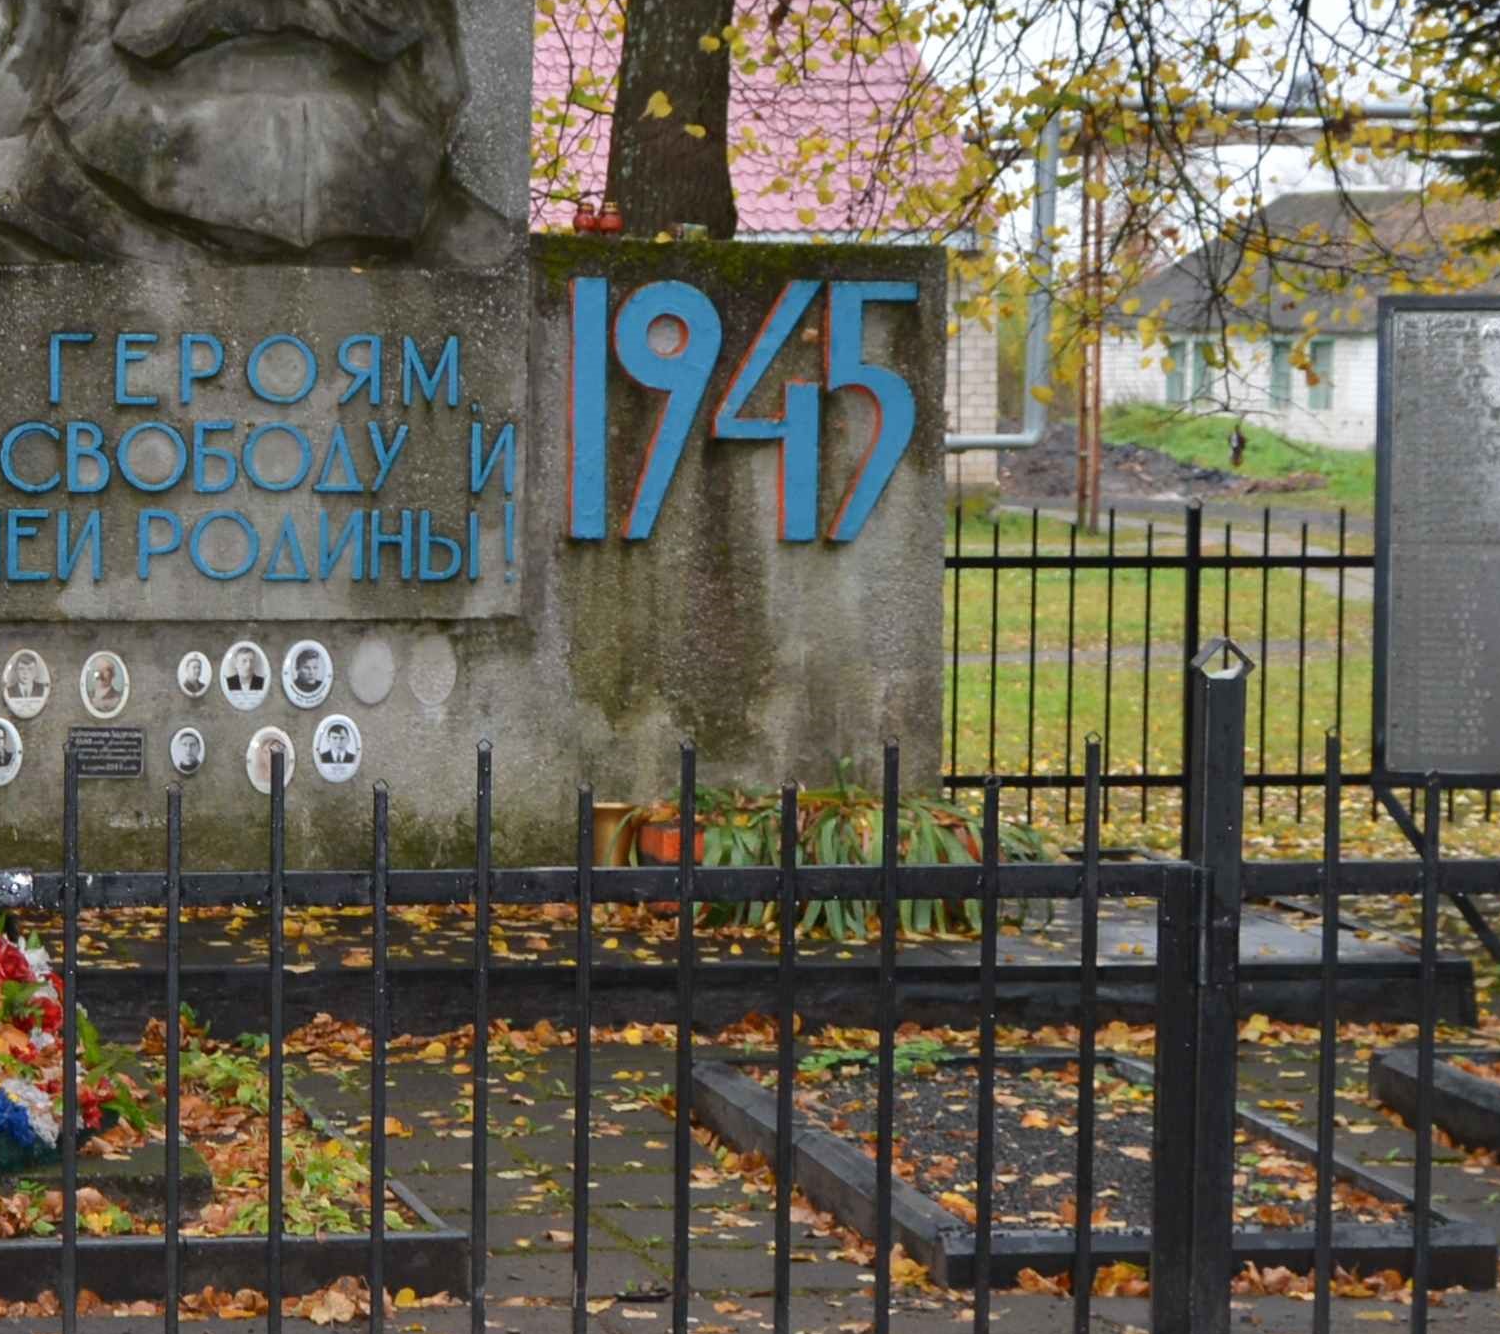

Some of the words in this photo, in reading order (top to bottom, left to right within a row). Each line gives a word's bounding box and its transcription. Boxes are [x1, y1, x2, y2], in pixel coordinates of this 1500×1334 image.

[573, 277, 920, 542] 1945
[471, 421, 516, 494] И
[138, 501, 516, 585] РОДИНЫ!
